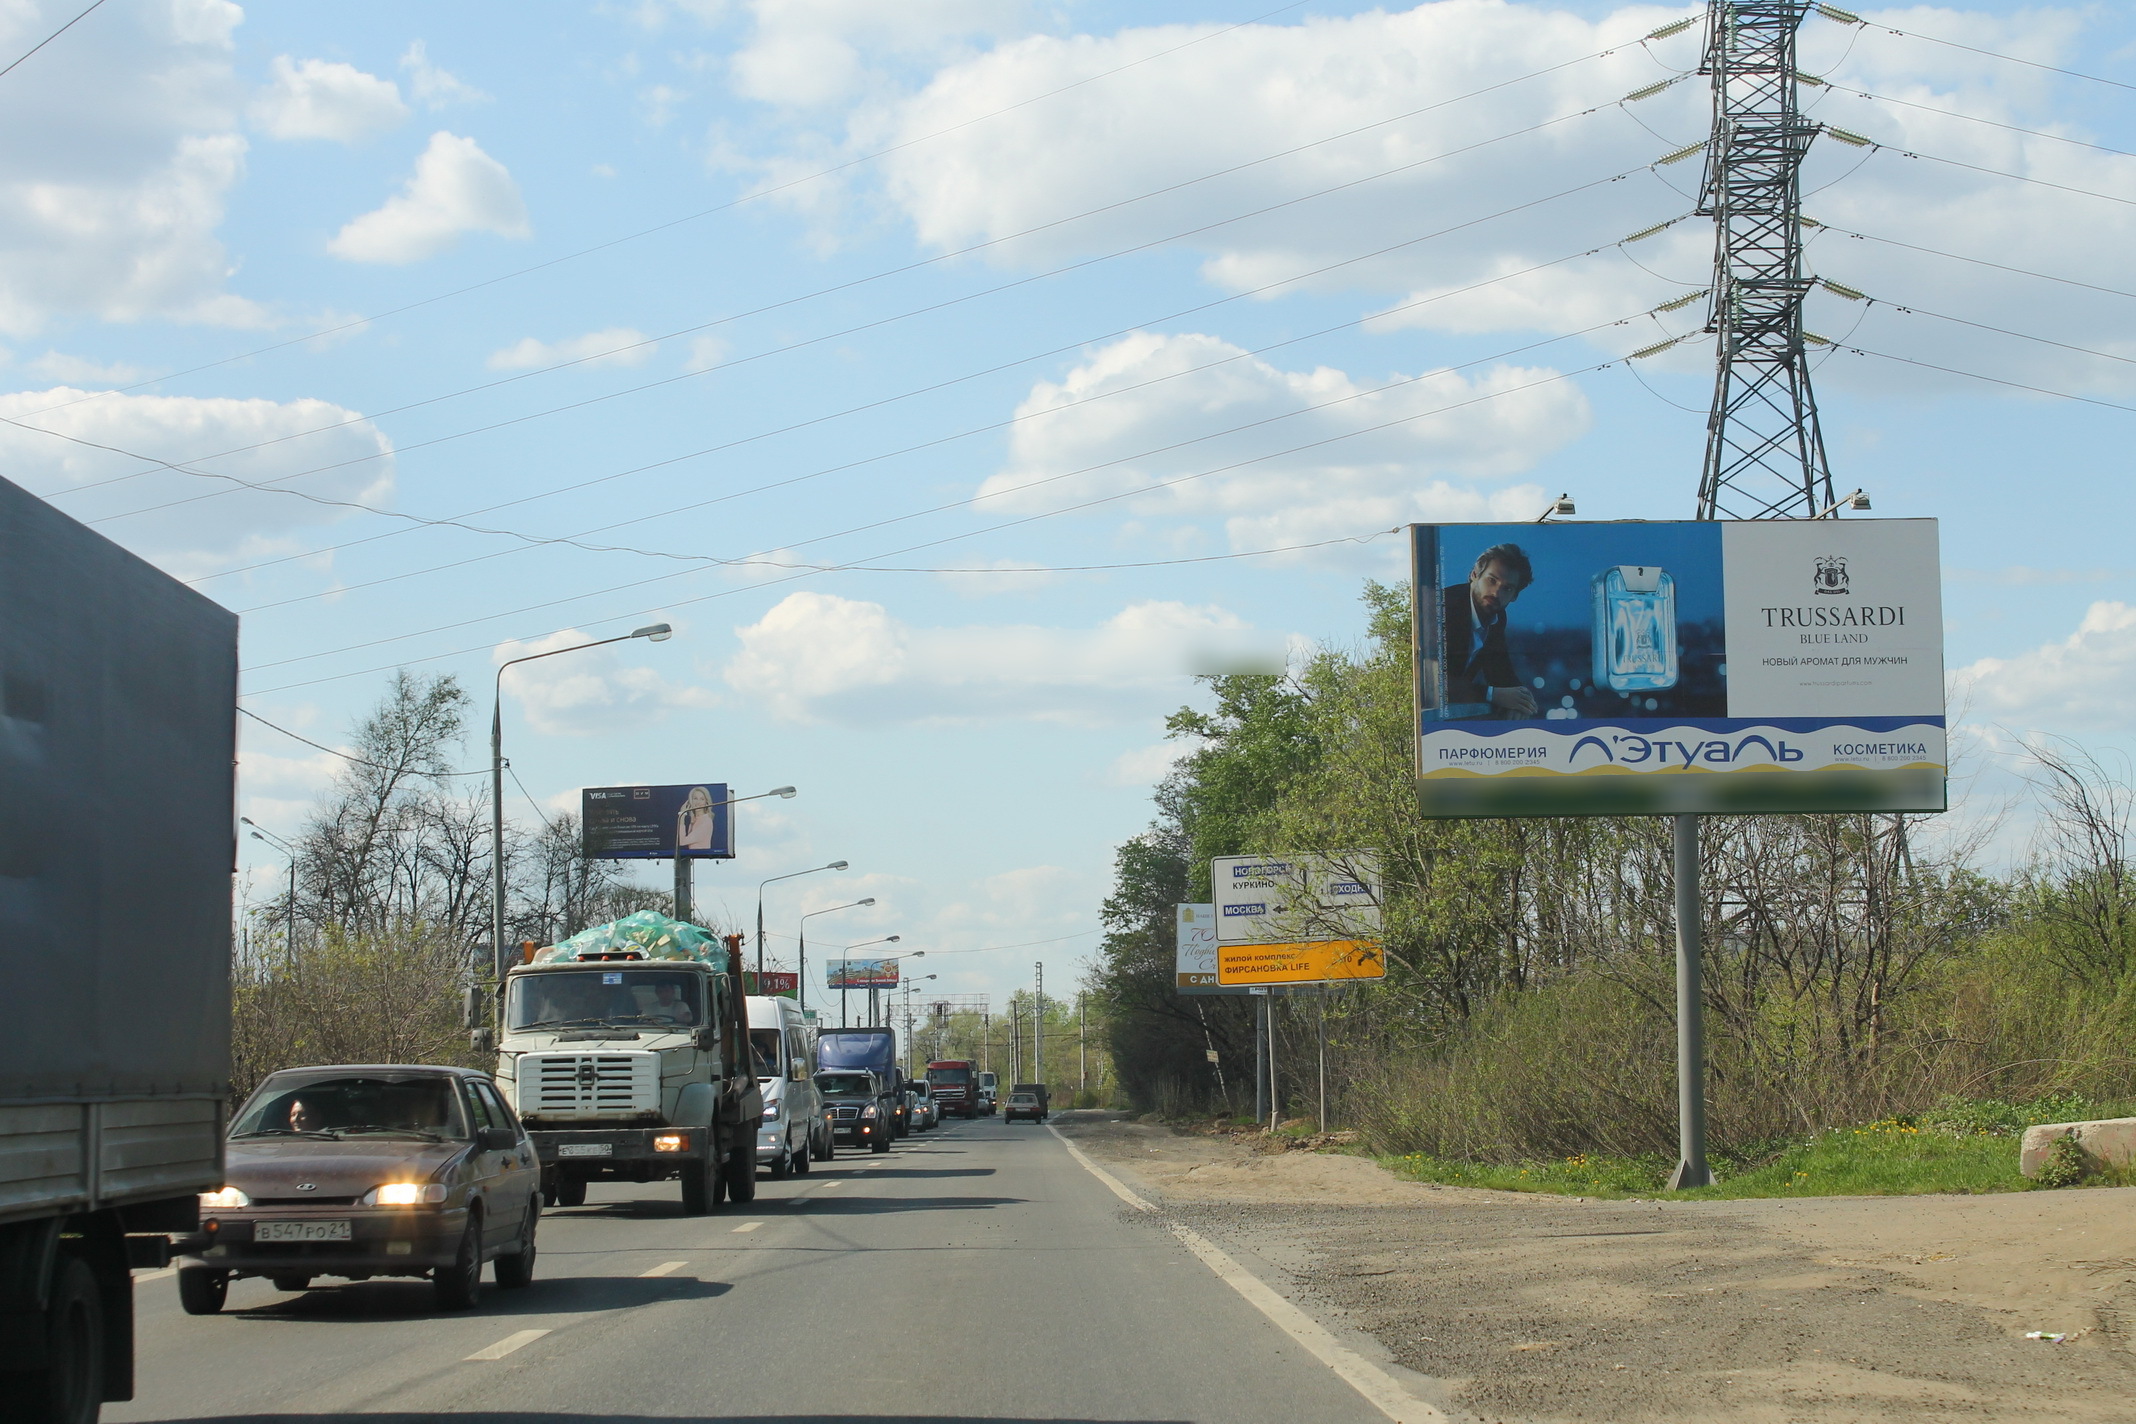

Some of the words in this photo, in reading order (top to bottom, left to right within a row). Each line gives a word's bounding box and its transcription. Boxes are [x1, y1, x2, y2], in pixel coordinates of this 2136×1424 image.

[1761, 606, 1905, 627] TRUSSARDI
[1800, 634, 1830, 644] BLUE
[1834, 633, 1869, 644] LAND
[1762, 656, 1798, 666] НОВЫЙ
[1800, 657, 1839, 666] АРОМАТ
[1841, 657, 1862, 667] ДЛЯ
[1863, 656, 1907, 665] МУЖЧИН
[1439, 747, 1547, 759] ПАРФЮМЕРИЯ
[1833, 743, 1927, 755] КОСМЕТИКА
[589, 792, 607, 800] VISA
[1232, 880, 1275, 890] КУРКИНО
[1333, 883, 1370, 894] СХОДН
[1225, 905, 1264, 915] МОСКВА
[1224, 954, 1253, 963] жилой
[1254, 953, 1296, 961] комплекс
[1224, 964, 1288, 974] ФИРСАНОВКА
[1290, 963, 1310, 971] LIFE
[1189, 975, 1198, 983] С
